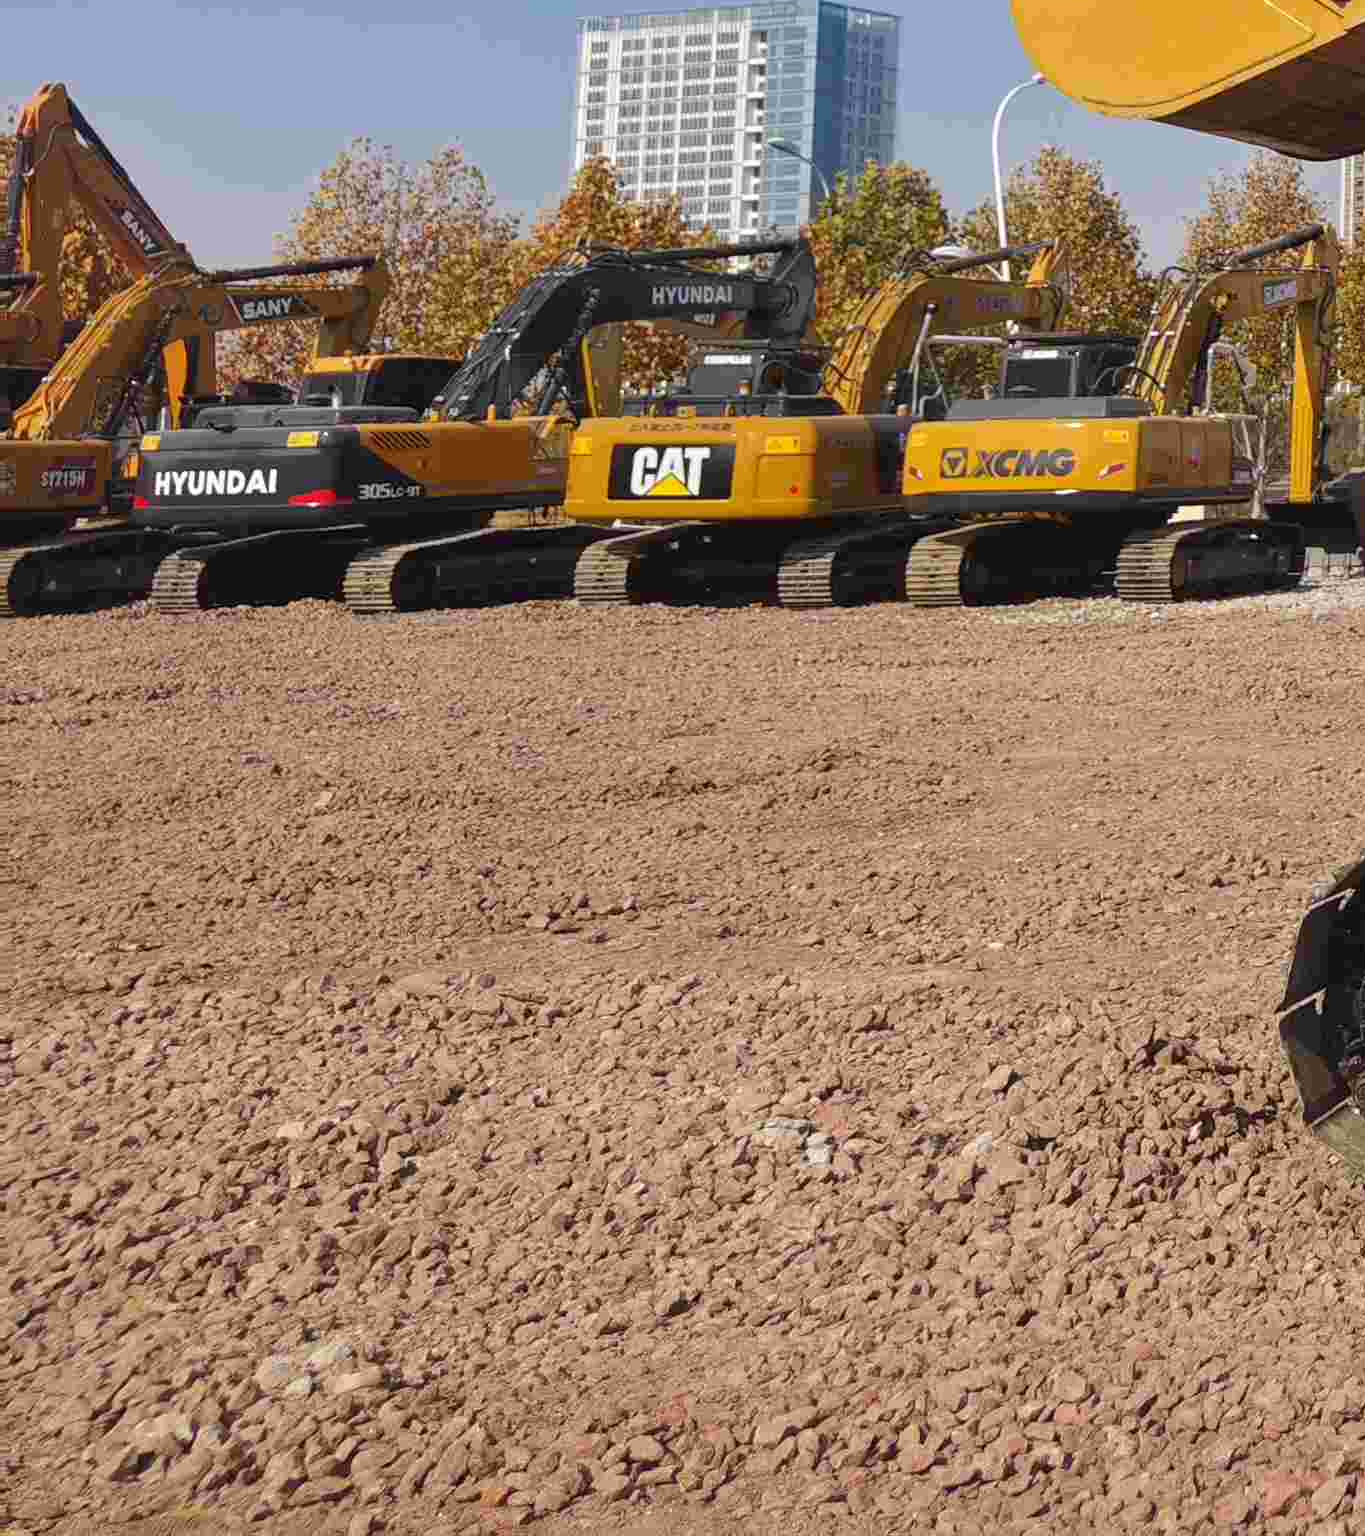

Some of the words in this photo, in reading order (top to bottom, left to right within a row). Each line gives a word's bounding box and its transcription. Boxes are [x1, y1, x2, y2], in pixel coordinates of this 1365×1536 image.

[243, 296, 292, 319] SANY
[652, 286, 732, 304] HYUNDAI
[630, 447, 711, 496] CAT
[968, 449, 1074, 477] XCMG
[154, 469, 277, 496] HYUNDAI
